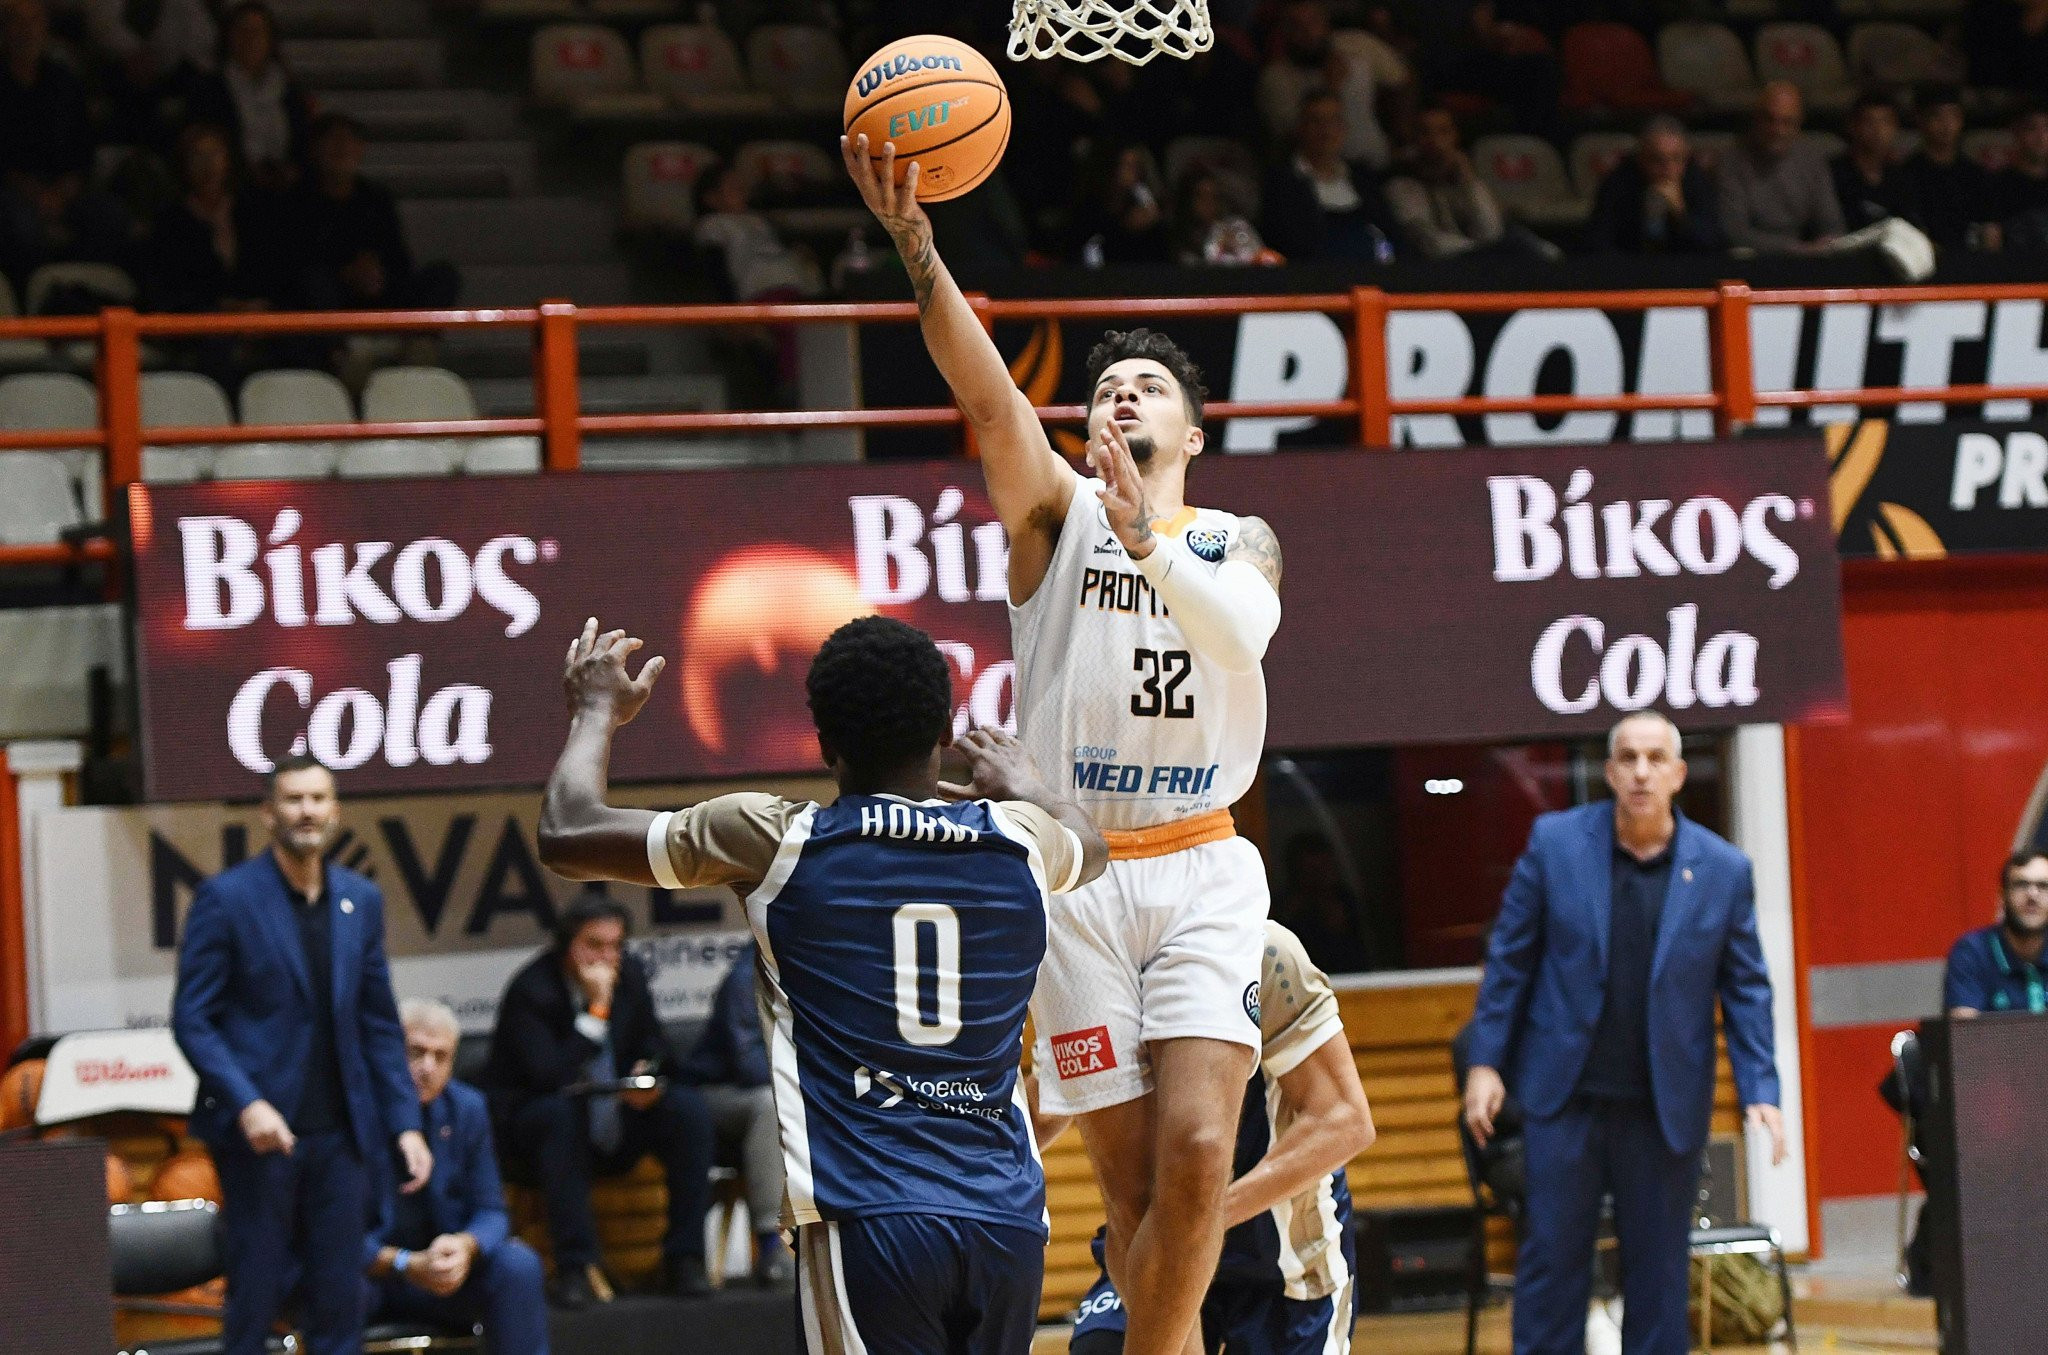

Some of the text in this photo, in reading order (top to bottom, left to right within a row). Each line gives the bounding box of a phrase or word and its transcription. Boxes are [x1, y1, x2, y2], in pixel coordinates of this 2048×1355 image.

[856, 54, 962, 97] Wilson
[1950, 432, 2048, 510] PR
[1080, 567, 1168, 618] PROM
[1131, 648, 1194, 718] 32
[1530, 603, 1759, 714] Cola
[227, 654, 493, 773] Cola
[1073, 746, 1117, 760] GROUP
[1073, 762, 1143, 793] MED
[893, 903, 963, 1046] 0
[1054, 1036, 1102, 1060] VIKOS
[1060, 1054, 1104, 1076] COLA
